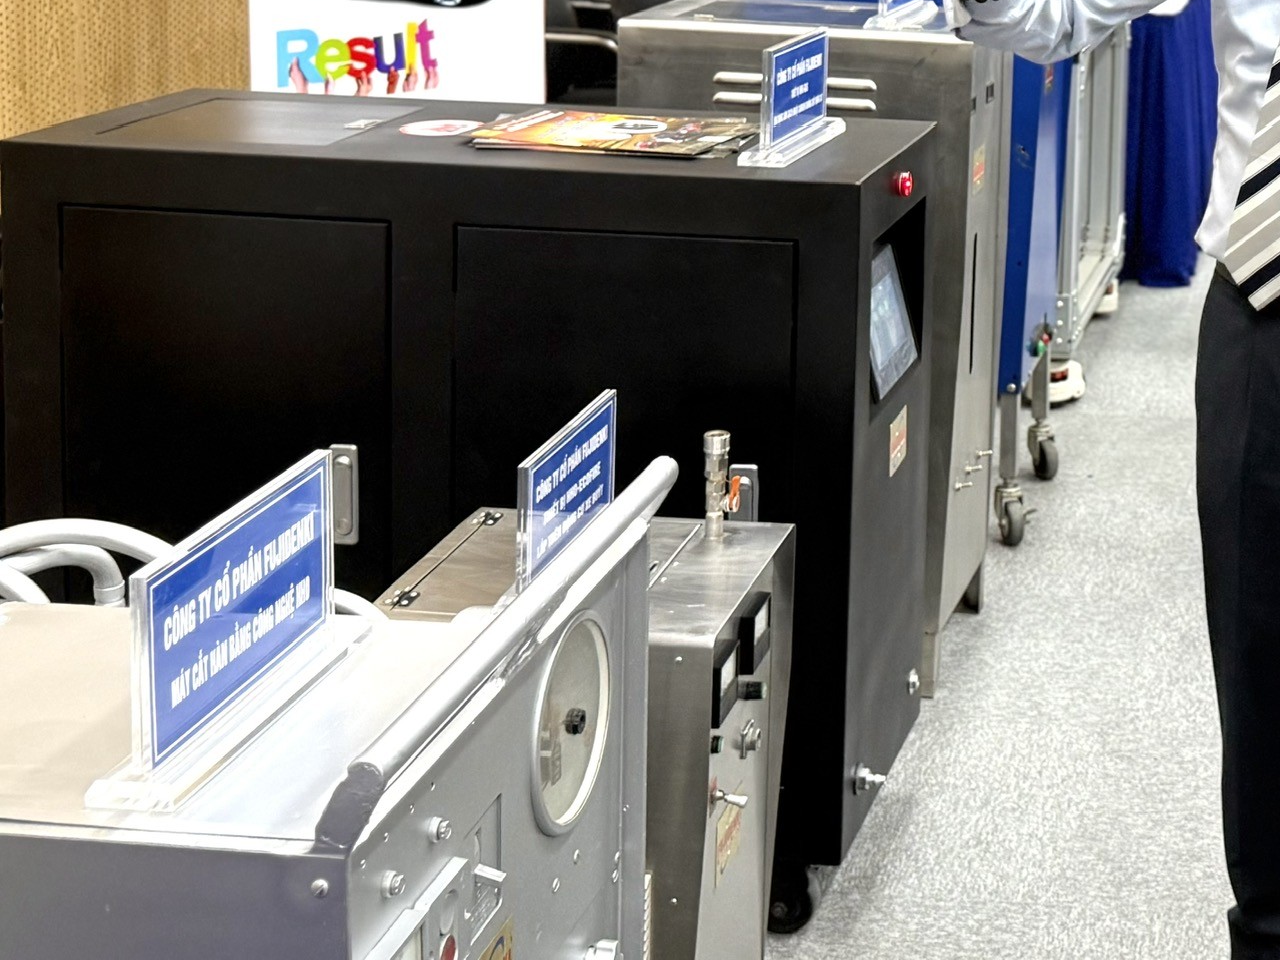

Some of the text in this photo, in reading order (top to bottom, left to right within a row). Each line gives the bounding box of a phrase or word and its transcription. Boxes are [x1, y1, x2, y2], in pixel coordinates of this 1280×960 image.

[276, 19, 438, 88] Result
[163, 511, 314, 651] CÔNG TY CỔ PHẦN FUJIDENKI
[171, 668, 190, 708] MÁY
[192, 650, 208, 691] CẮT
[229, 621, 251, 661] BẰNG
[252, 604, 274, 642] CÔNG
[274, 582, 294, 625] NGHỆ
[296, 576, 310, 608] HHO
